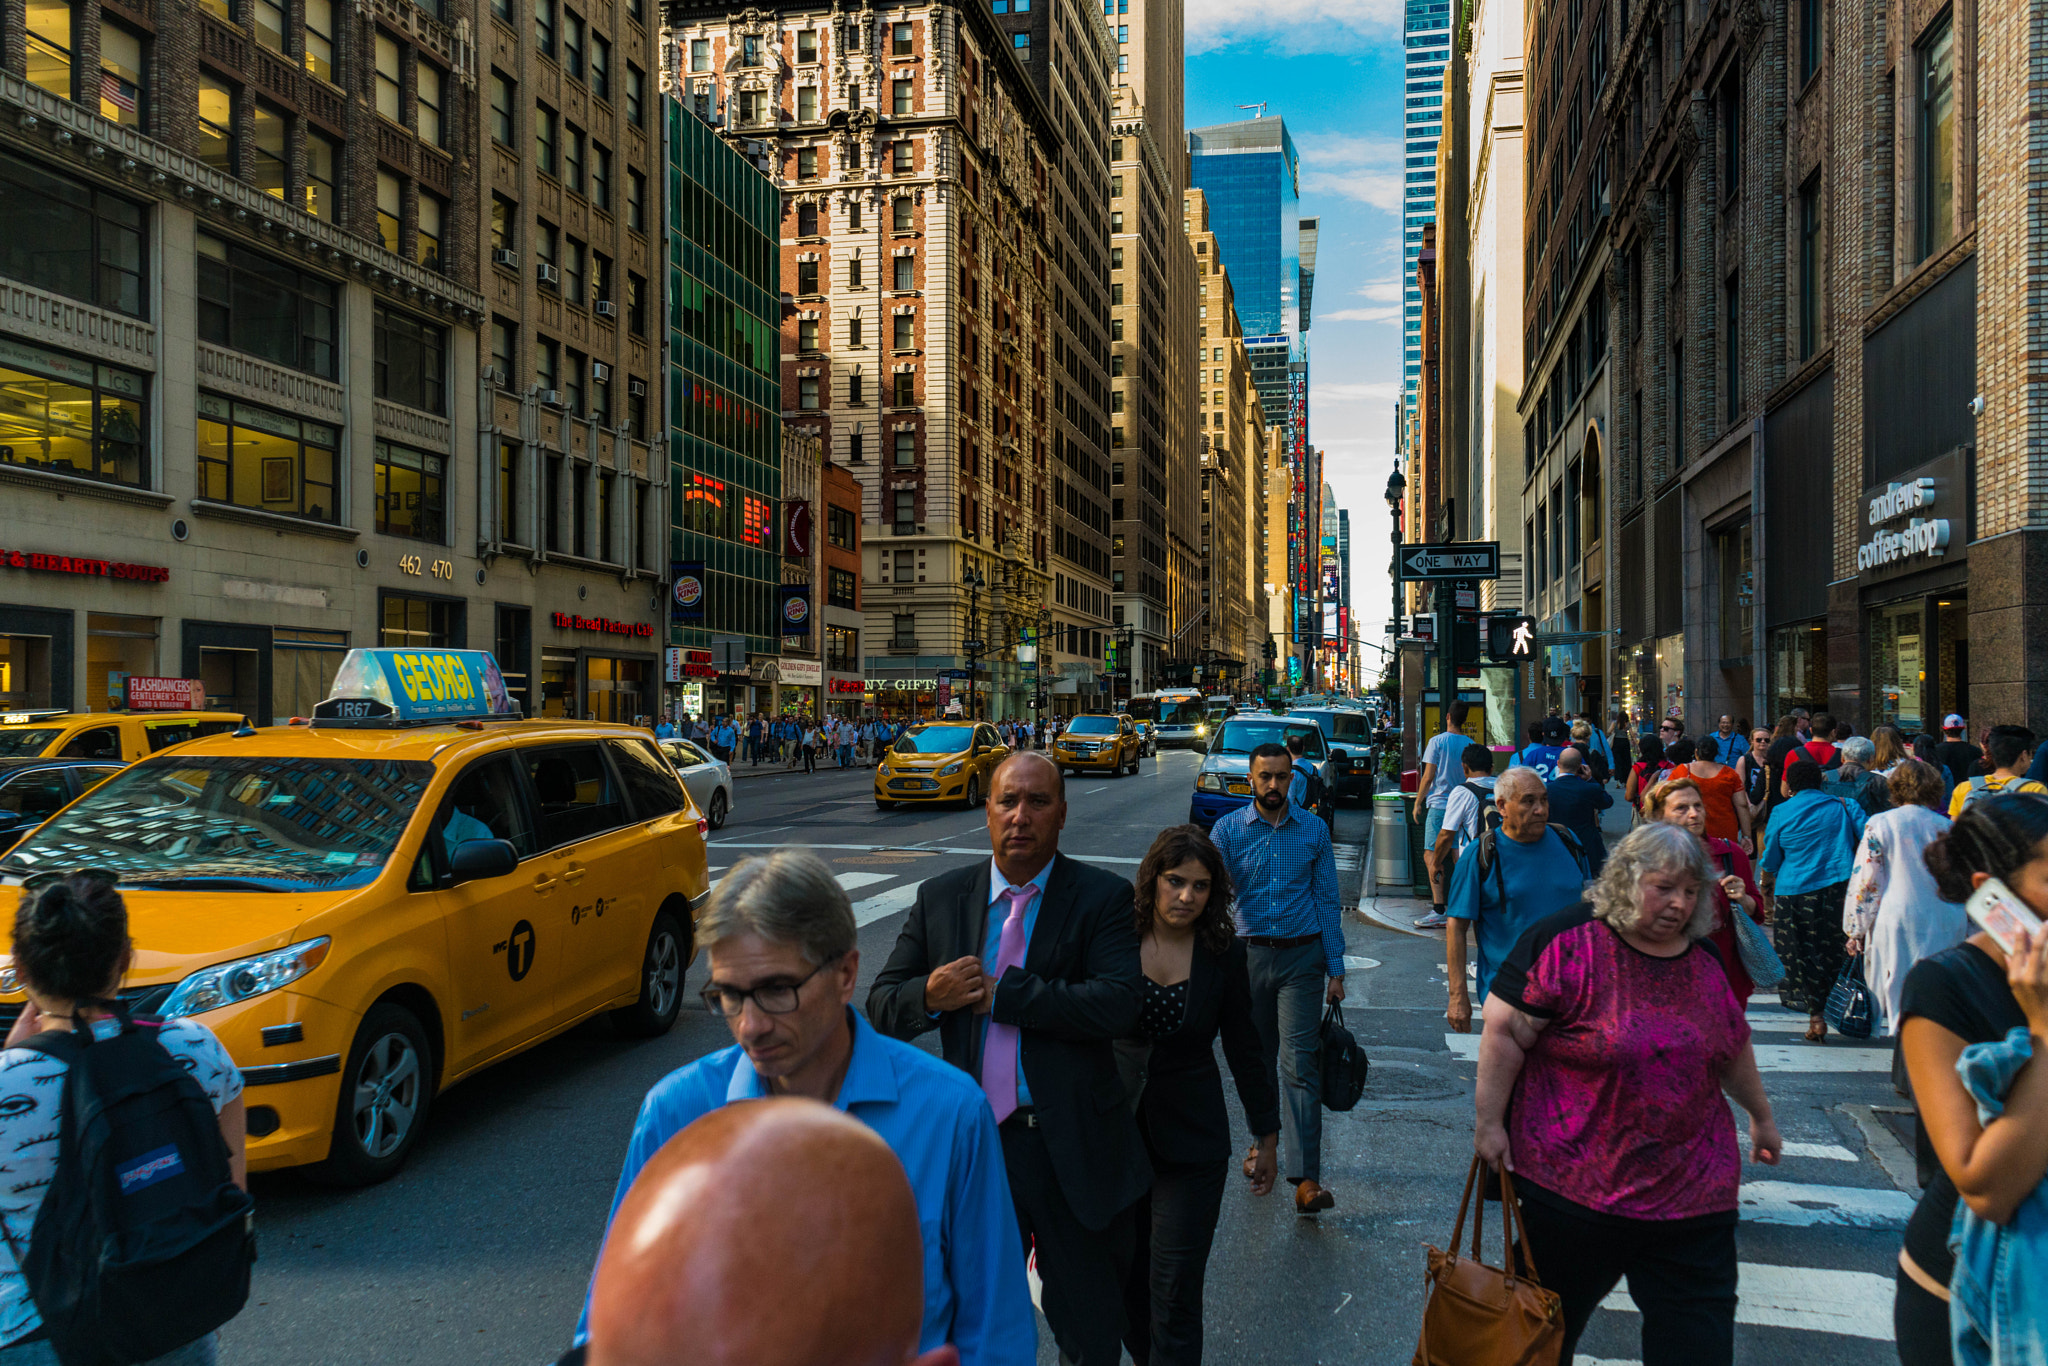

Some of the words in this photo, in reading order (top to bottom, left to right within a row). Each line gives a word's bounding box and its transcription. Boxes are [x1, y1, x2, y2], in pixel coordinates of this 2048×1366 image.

[1297, 381, 1306, 463] ERNST
[1297, 481, 1306, 493] &
[1869, 478, 1932, 525] andrews
[1297, 510, 1307, 591] YOUNG
[1858, 529, 1901, 571] coffee
[1902, 518, 1948, 557] shop
[9, 550, 25, 567] &
[29, 553, 110, 576] HEARTY
[112, 562, 169, 582] SOUPS
[399, 554, 421, 576] 462
[431, 560, 452, 580] 470
[1416, 556, 1441, 567] ONE
[1453, 555, 1481, 567] WAY
[677, 581, 698, 592] BURGER
[677, 586, 699, 600] KING
[786, 601, 805, 611] BURGER
[787, 606, 806, 617] KING
[555, 612, 573, 628] The
[575, 615, 601, 631] Bread
[603, 618, 635, 638] Factory
[636, 622, 654, 637] Cafe
[131, 678, 190, 692] FLASHDANCERS
[894, 679, 937, 691] GIFTS
[1528, 660, 1536, 699] ewsstand
[130, 691, 175, 701] GENTLEMEN'S
[176, 693, 190, 701] CLUB
[138, 700, 152, 708] 52ND
[336, 702, 371, 717] 1R67
